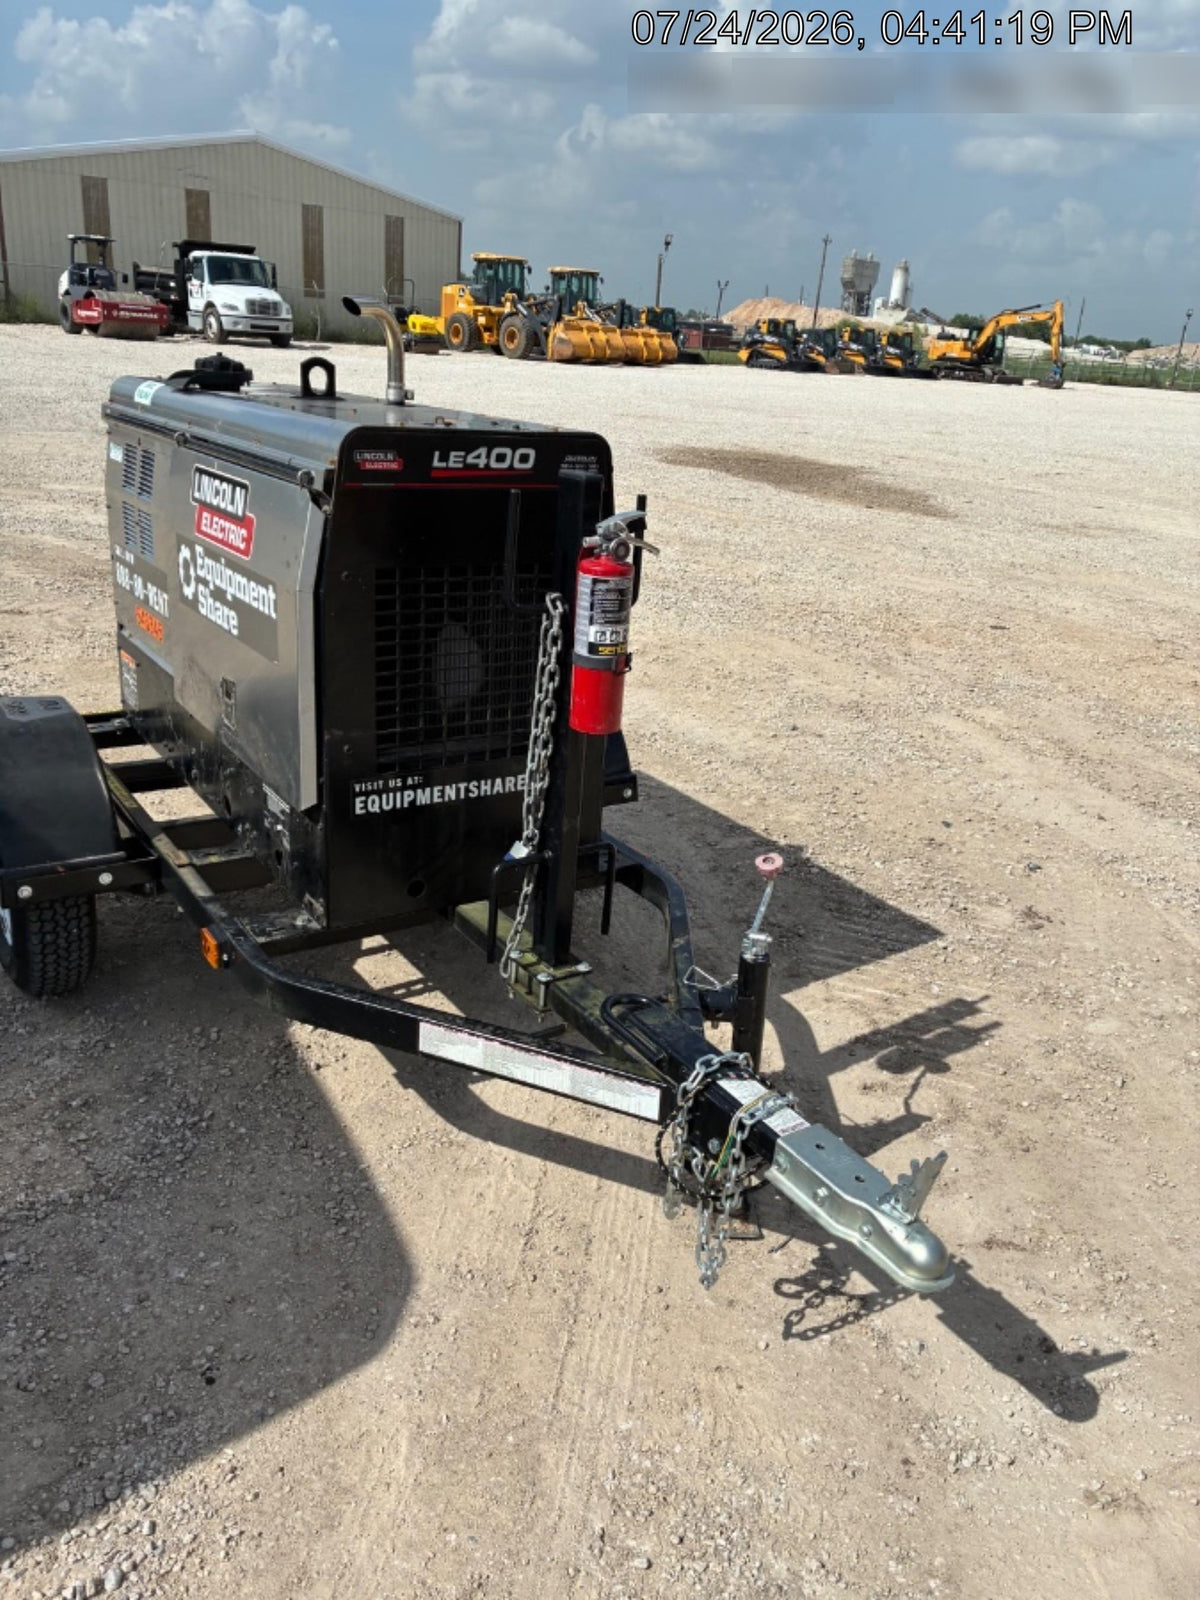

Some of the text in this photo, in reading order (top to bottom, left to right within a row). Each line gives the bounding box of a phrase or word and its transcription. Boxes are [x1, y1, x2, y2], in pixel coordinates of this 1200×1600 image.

[356, 452, 395, 460] LINCOLN
[432, 447, 536, 470] LE400
[193, 472, 247, 517] LINCOLN
[201, 511, 248, 550] ELECTRIC
[195, 544, 277, 620] Equipment
[198, 584, 240, 636] Share
[353, 776, 423, 792] VISIT US AT:
[354, 774, 527, 815] EQUIPMENTSHARE
